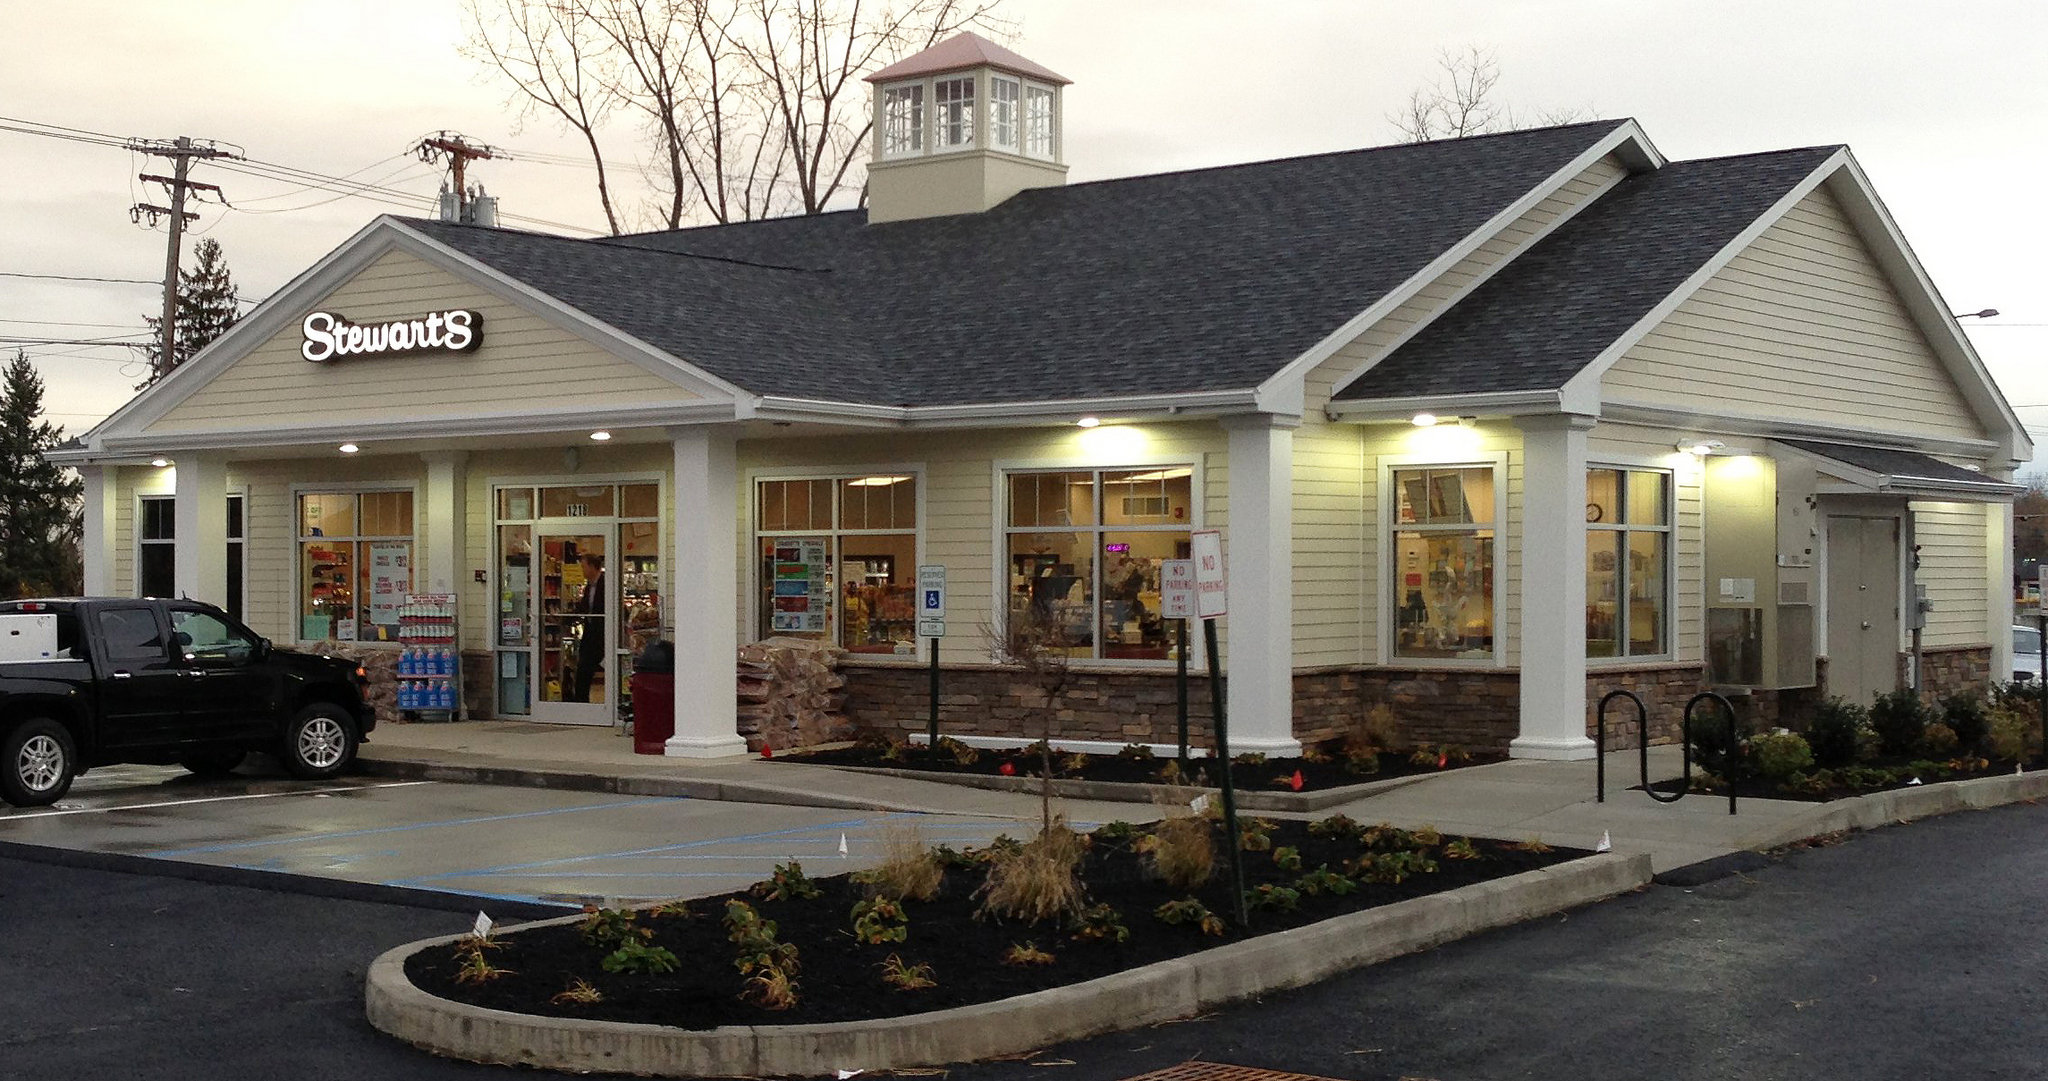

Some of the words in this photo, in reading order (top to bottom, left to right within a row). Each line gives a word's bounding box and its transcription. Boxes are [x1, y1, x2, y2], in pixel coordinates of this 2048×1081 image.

[302, 310, 472, 361] Stewart's
[1201, 554, 1215, 571] NO
[1172, 565, 1185, 577] NO
[1165, 579, 1193, 590] PARKING
[1199, 580, 1224, 593] PARKING
[1172, 594, 1186, 602] ANY
[1171, 604, 1186, 612] TIME
